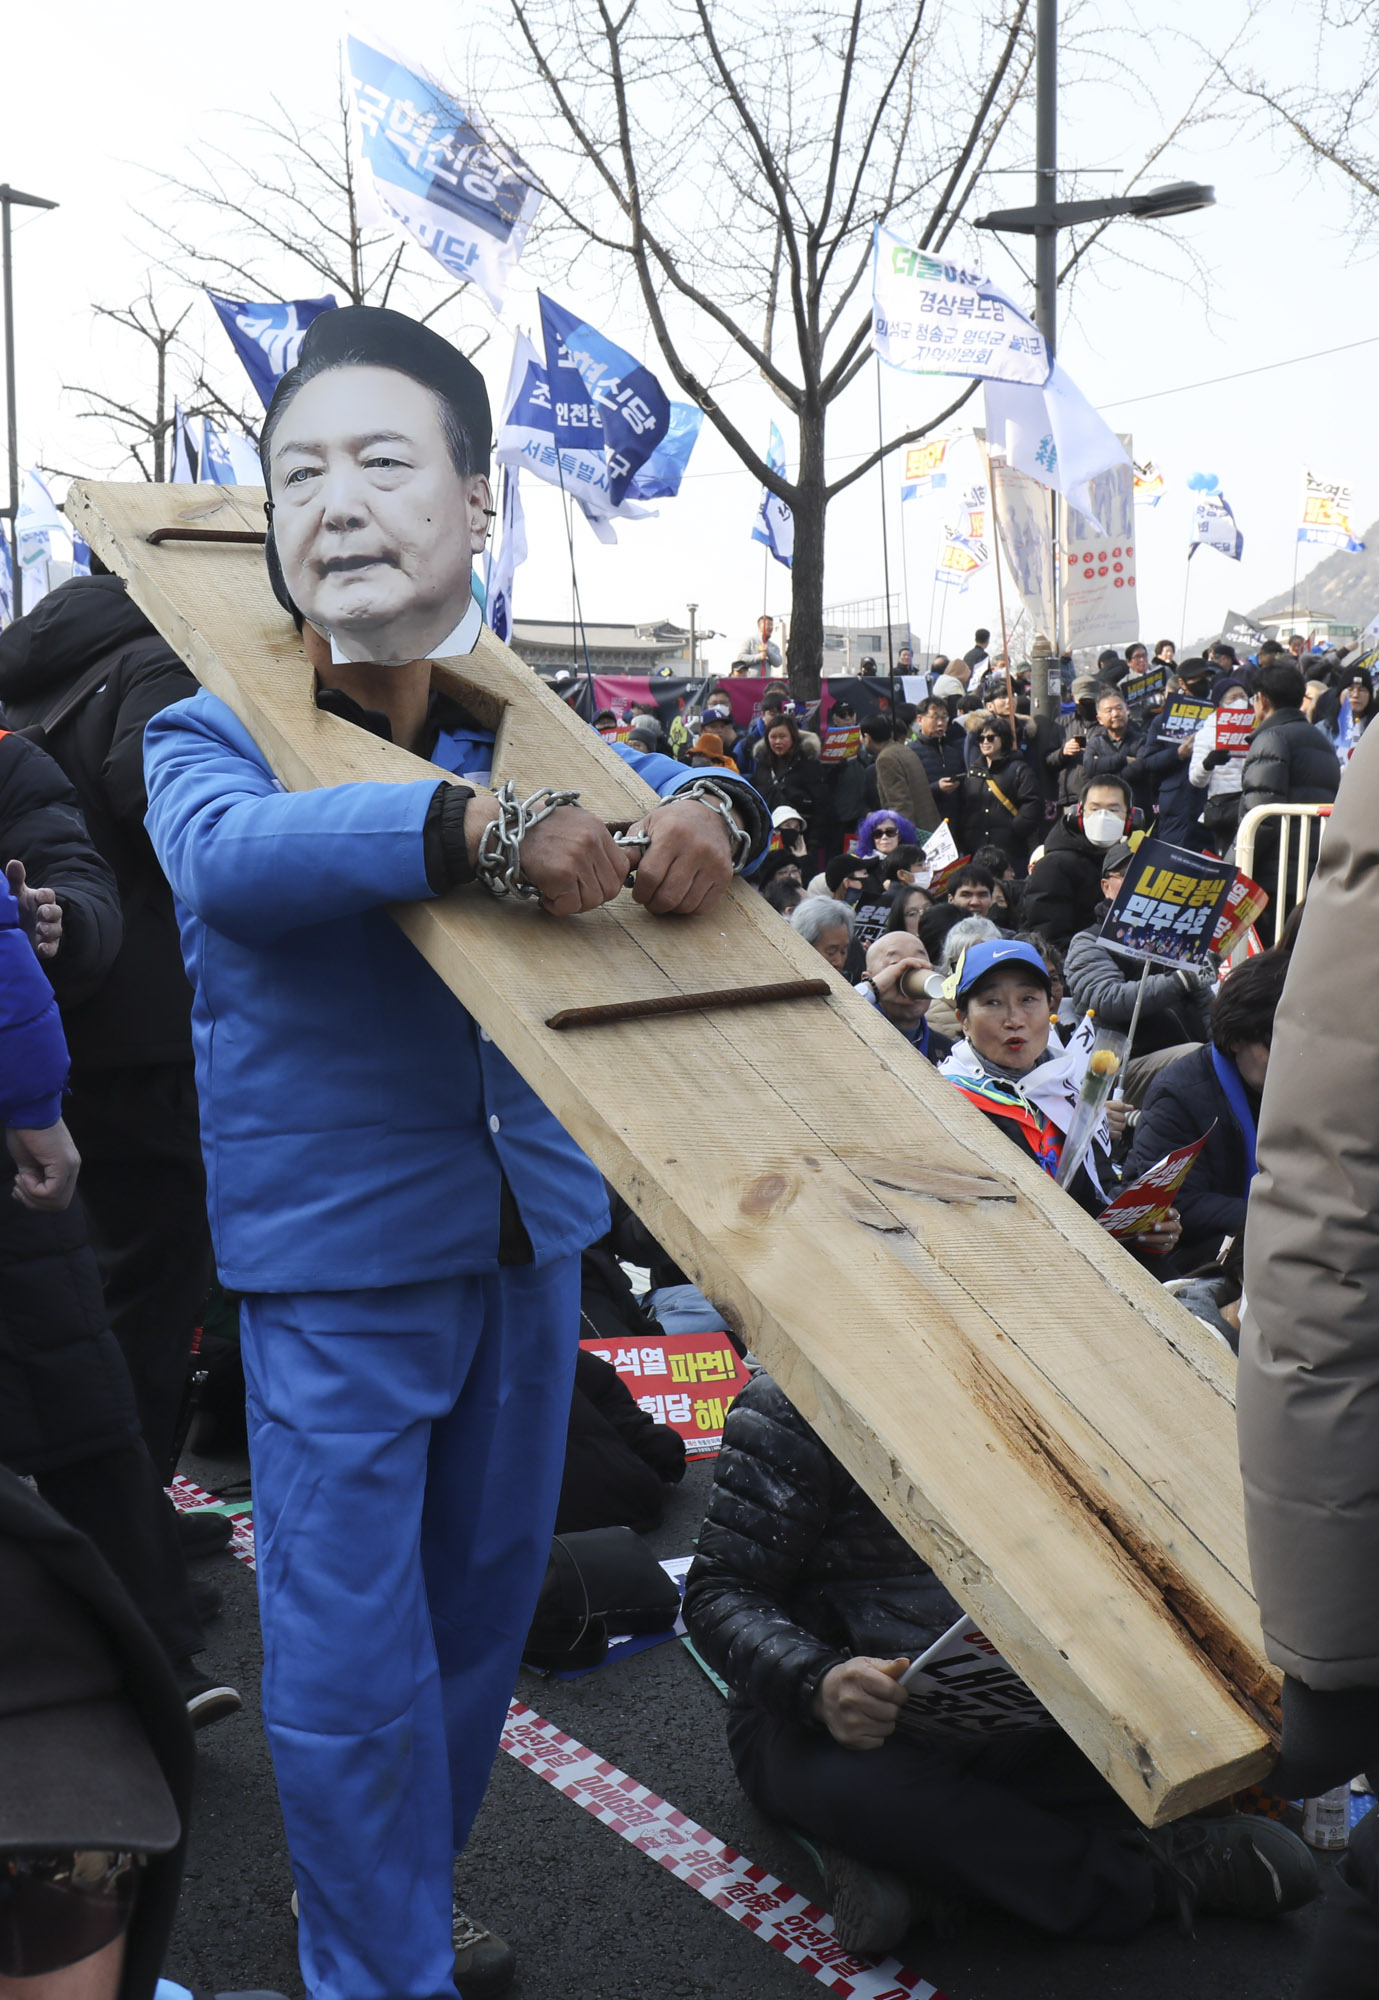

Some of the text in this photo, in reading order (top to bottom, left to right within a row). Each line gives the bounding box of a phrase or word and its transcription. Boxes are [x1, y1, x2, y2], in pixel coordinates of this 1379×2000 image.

[351, 76, 526, 203] 국혁신당
[667, 1348, 738, 1383] 파면!
[503, 1724, 873, 1979] 안전제일 DANGER! 위험 危險 안전제일
